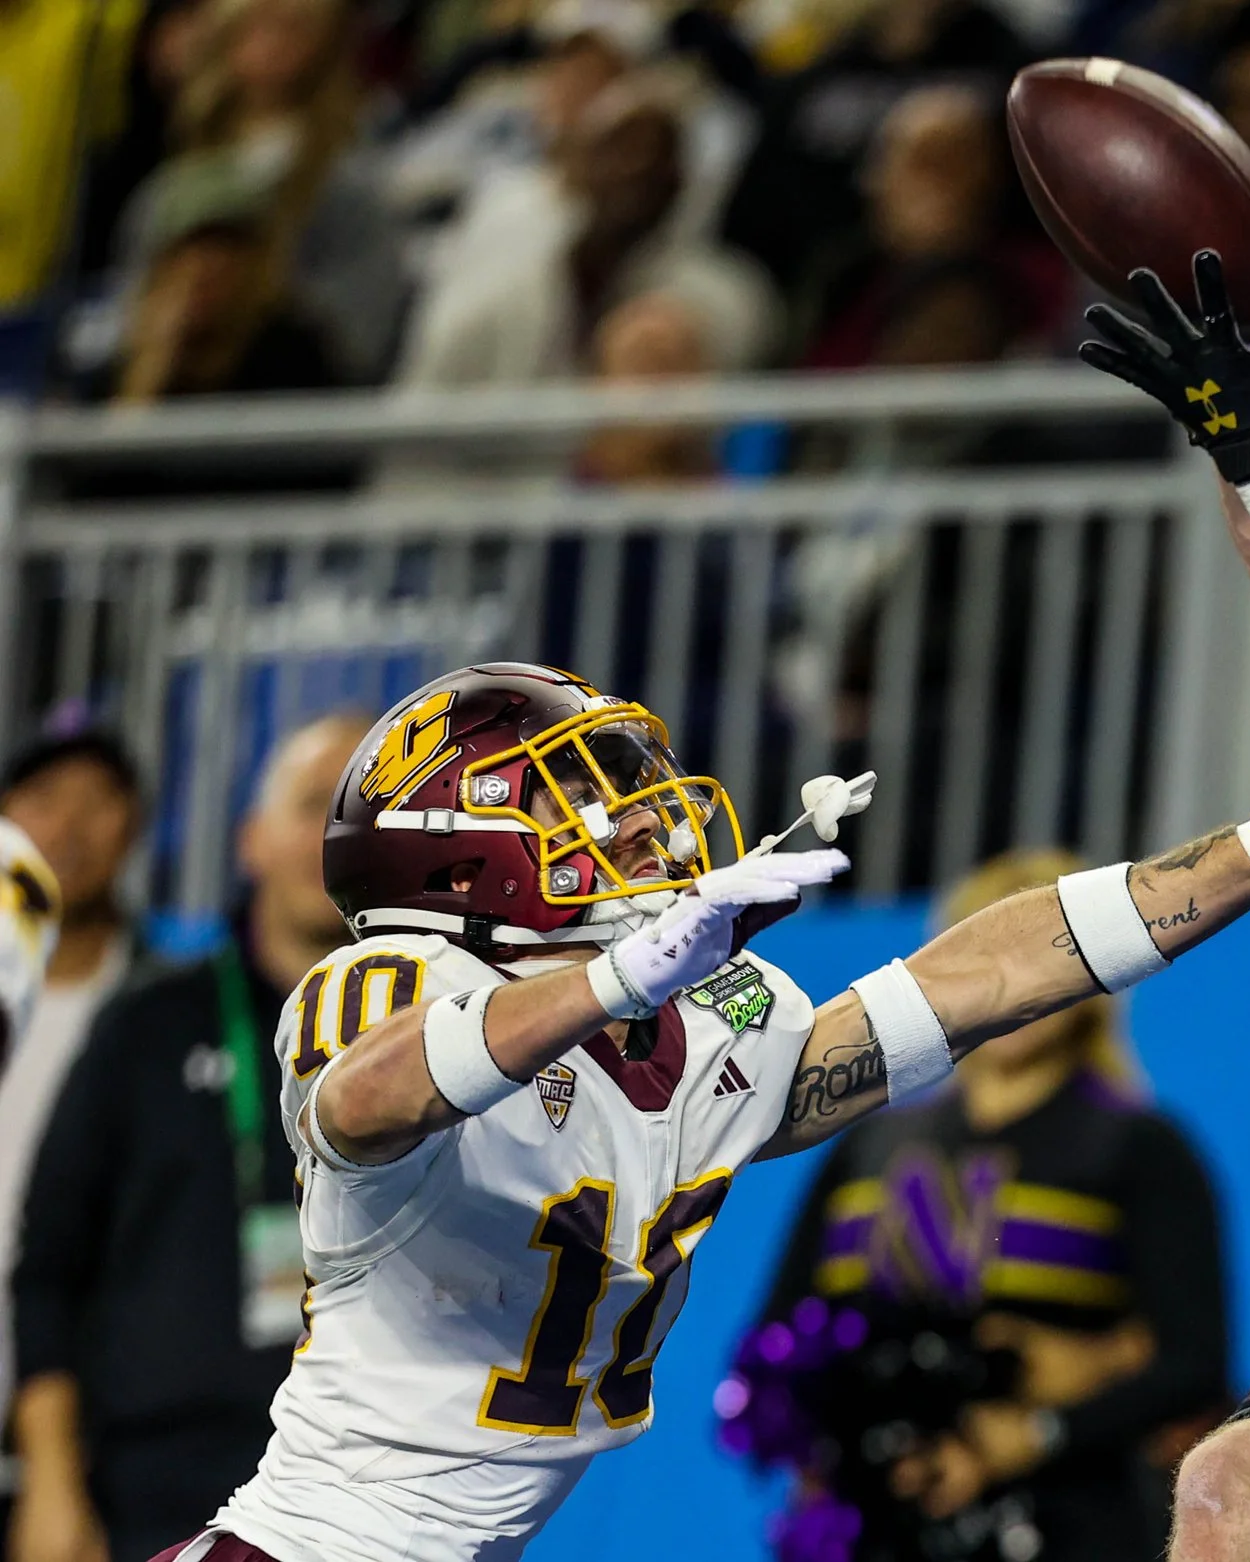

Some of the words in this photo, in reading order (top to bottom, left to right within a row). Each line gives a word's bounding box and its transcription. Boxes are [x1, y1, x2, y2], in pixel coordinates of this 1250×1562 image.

[1146, 897, 1201, 930] rent
[291, 951, 428, 1081] 10
[722, 981, 771, 1033] Bowl
[538, 1079, 575, 1102] MAC
[476, 1166, 735, 1437] 10
